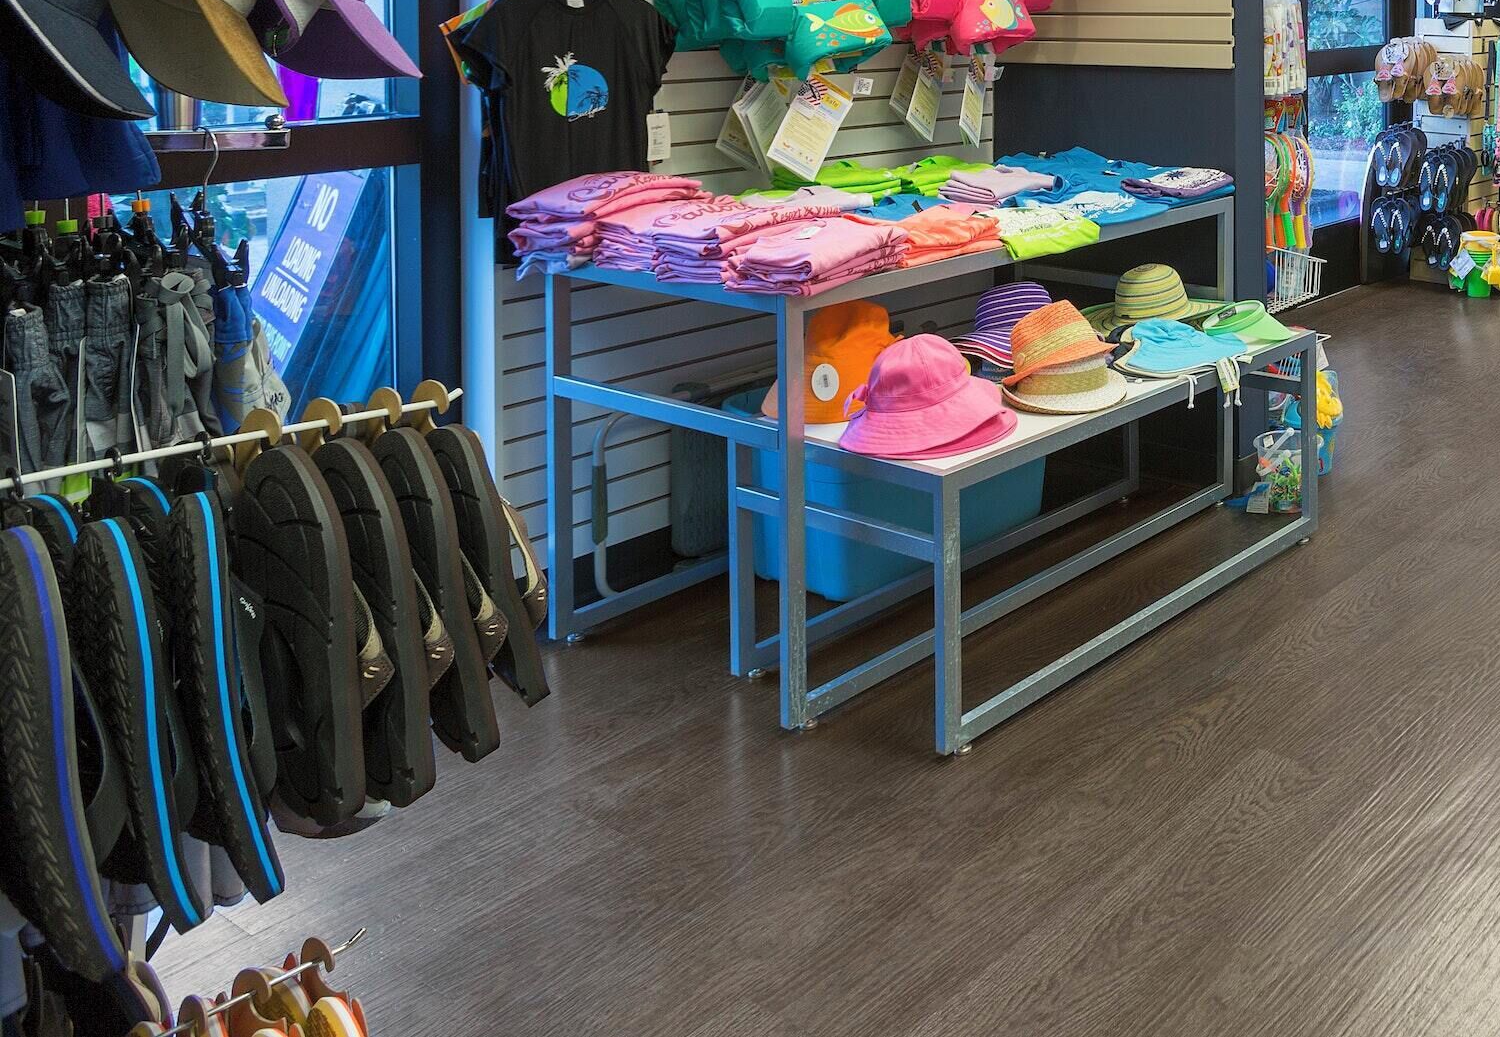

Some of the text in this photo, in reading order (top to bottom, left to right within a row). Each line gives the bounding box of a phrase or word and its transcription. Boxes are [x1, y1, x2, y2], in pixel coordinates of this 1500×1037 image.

[306, 183, 340, 232] NO
[281, 235, 322, 283] LOADING
[260, 271, 308, 324] UNLOADING
